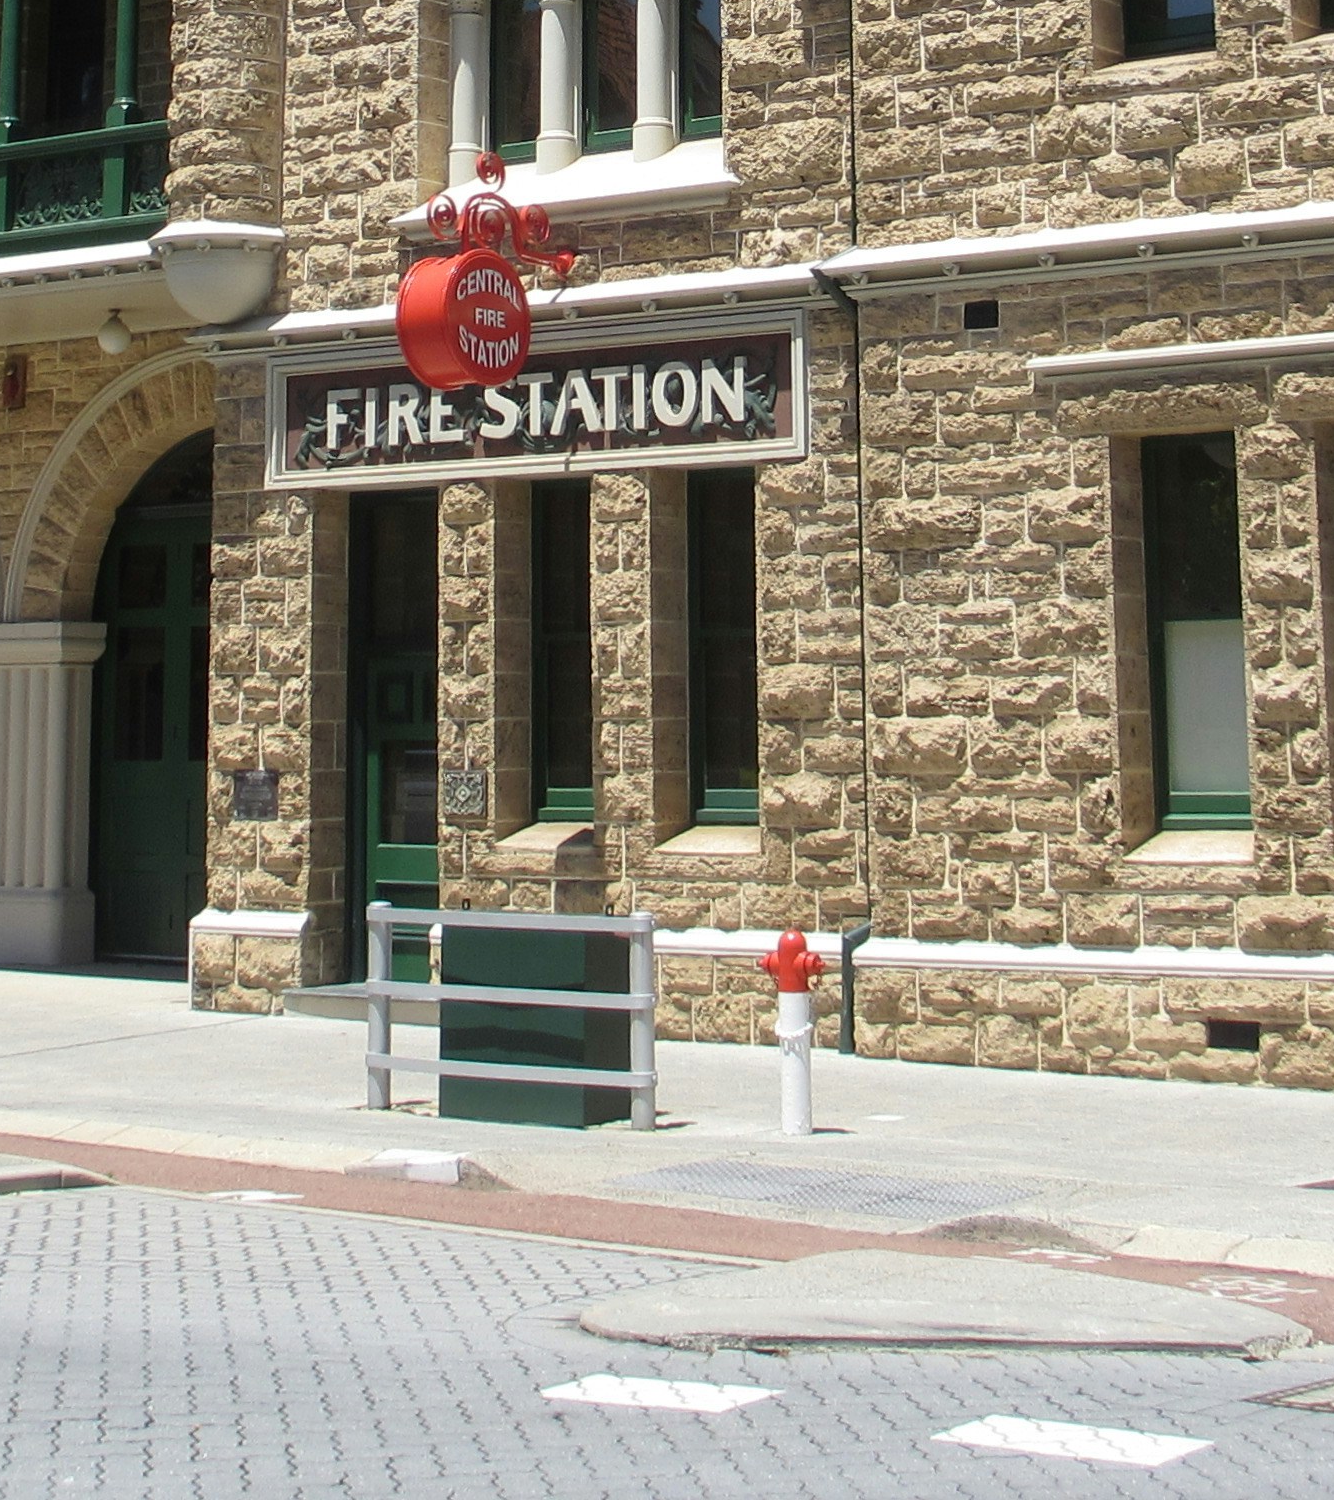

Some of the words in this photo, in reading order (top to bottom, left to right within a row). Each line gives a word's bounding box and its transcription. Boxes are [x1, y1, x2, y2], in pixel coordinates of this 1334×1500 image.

[456, 268, 522, 312] CENTRAL
[475, 307, 506, 328] FIRE
[459, 325, 519, 368] STATION
[326, 382, 465, 450] FIRE
[479, 356, 747, 439] STATION
